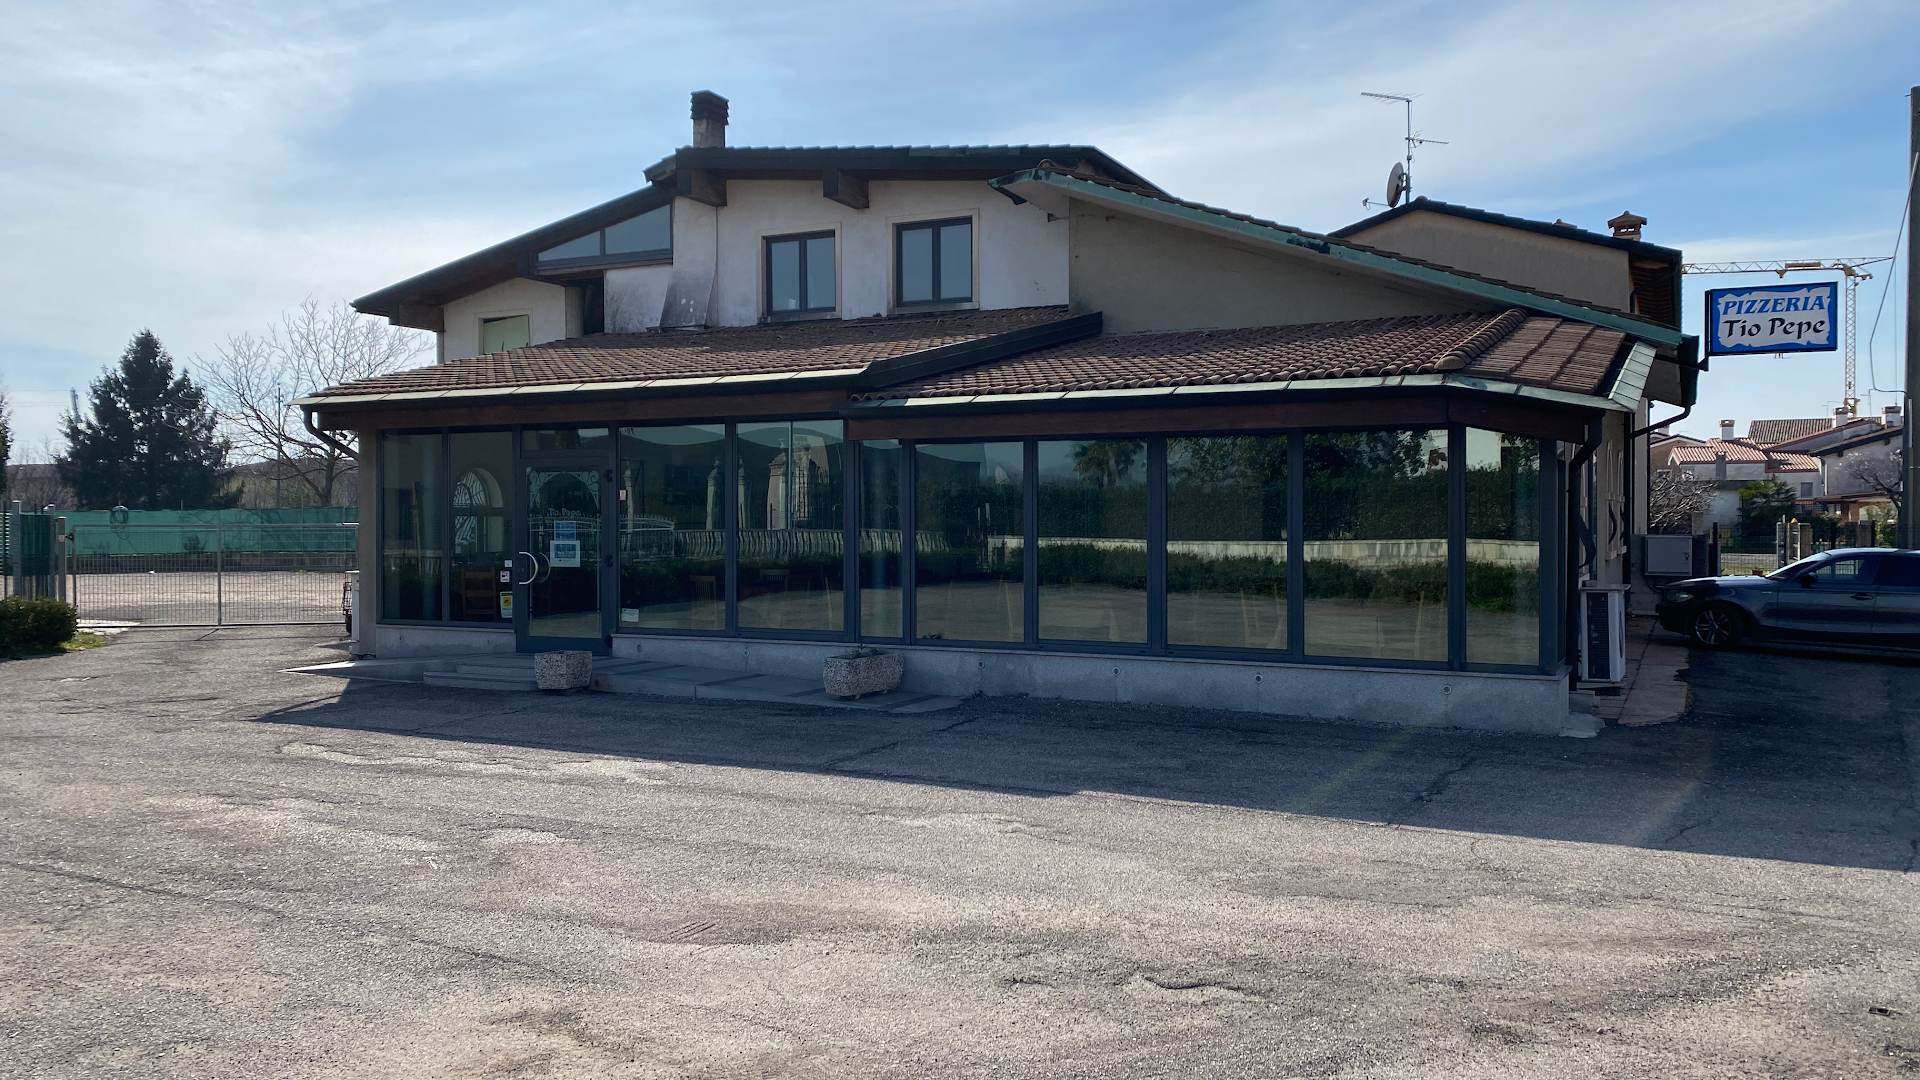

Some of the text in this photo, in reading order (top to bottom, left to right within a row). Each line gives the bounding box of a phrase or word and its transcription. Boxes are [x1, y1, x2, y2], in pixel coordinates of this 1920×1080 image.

[1722, 296, 1826, 315] PIZZERIA
[1722, 317, 1826, 339] Tio Pepe
